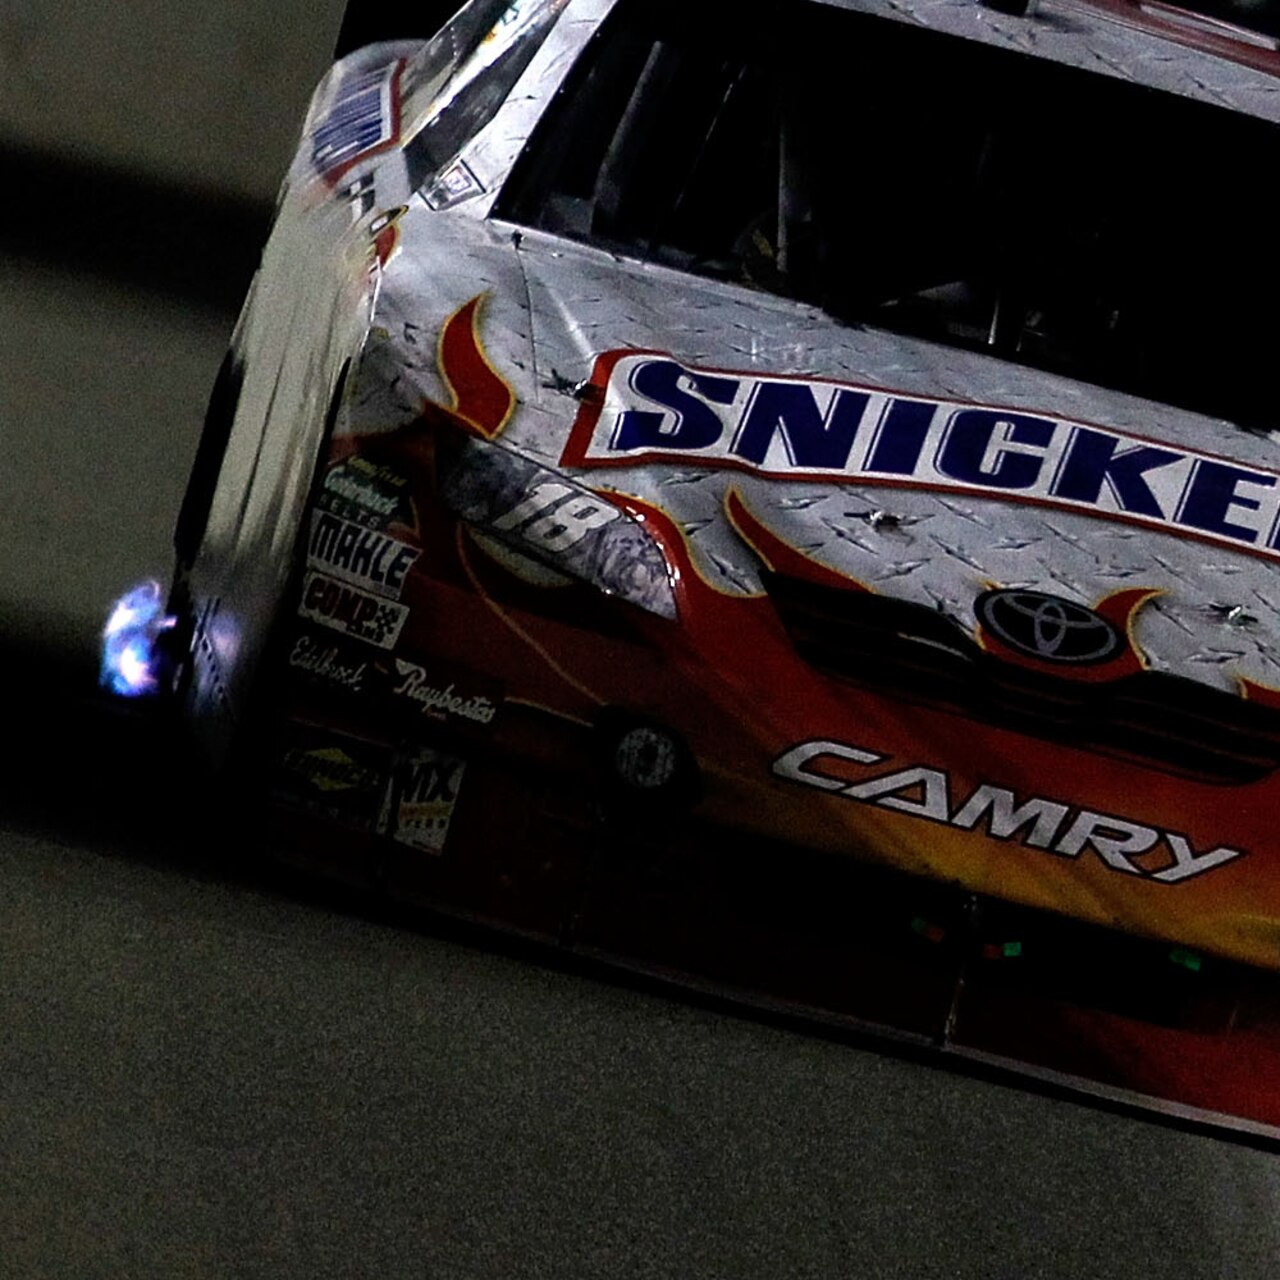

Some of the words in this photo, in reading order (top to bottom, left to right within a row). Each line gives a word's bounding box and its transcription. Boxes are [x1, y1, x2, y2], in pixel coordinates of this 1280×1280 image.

[311, 514, 421, 589] MAHLE
[491, 482, 623, 553] 18
[305, 577, 379, 621] COMP
[770, 739, 1246, 883] CAMRY
